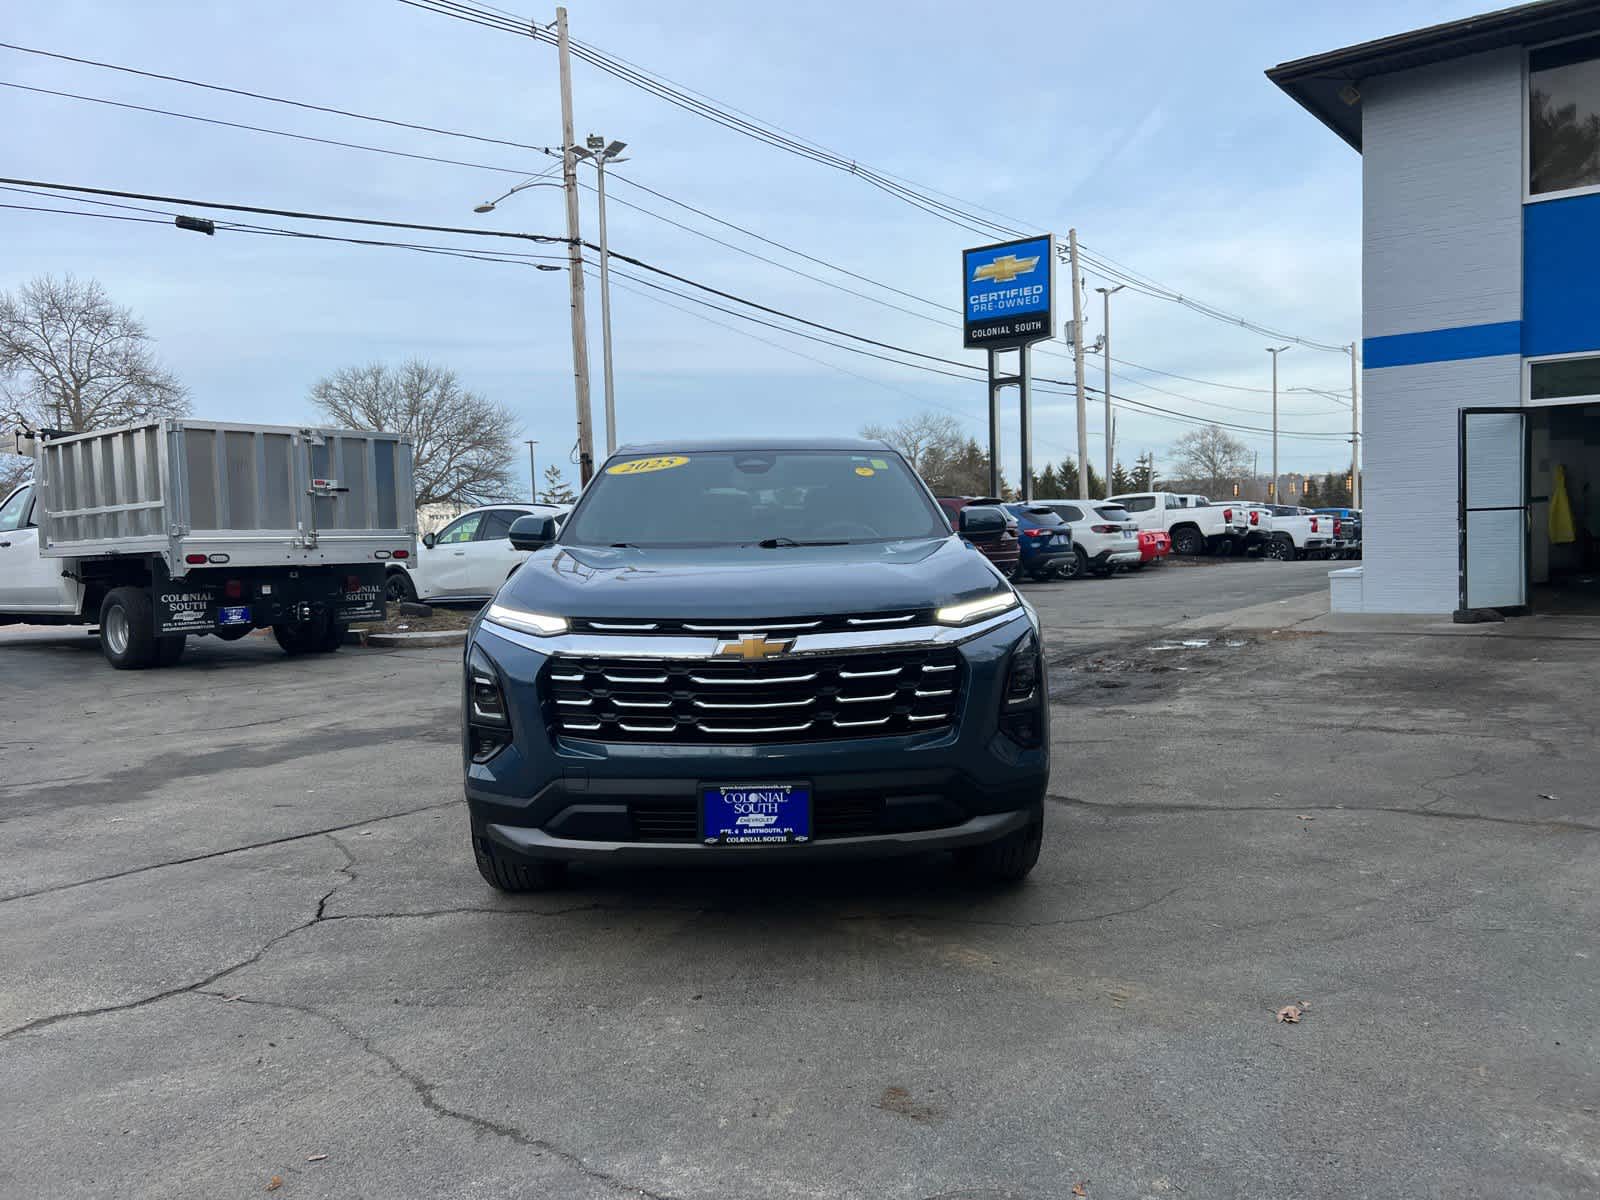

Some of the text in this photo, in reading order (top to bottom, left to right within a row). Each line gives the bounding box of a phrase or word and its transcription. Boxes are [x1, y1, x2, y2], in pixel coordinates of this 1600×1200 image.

[970, 285, 1043, 304] CERTIFIED
[973, 295, 1040, 312] PRE-OWNED
[972, 321, 1041, 338] COLONIAL SOUTH
[621, 457, 677, 472] 2025
[161, 593, 214, 603] COLONIAL
[169, 602, 207, 611] SOUTH
[724, 792, 788, 803] COLONIAL
[734, 803, 778, 814] SOUTH
